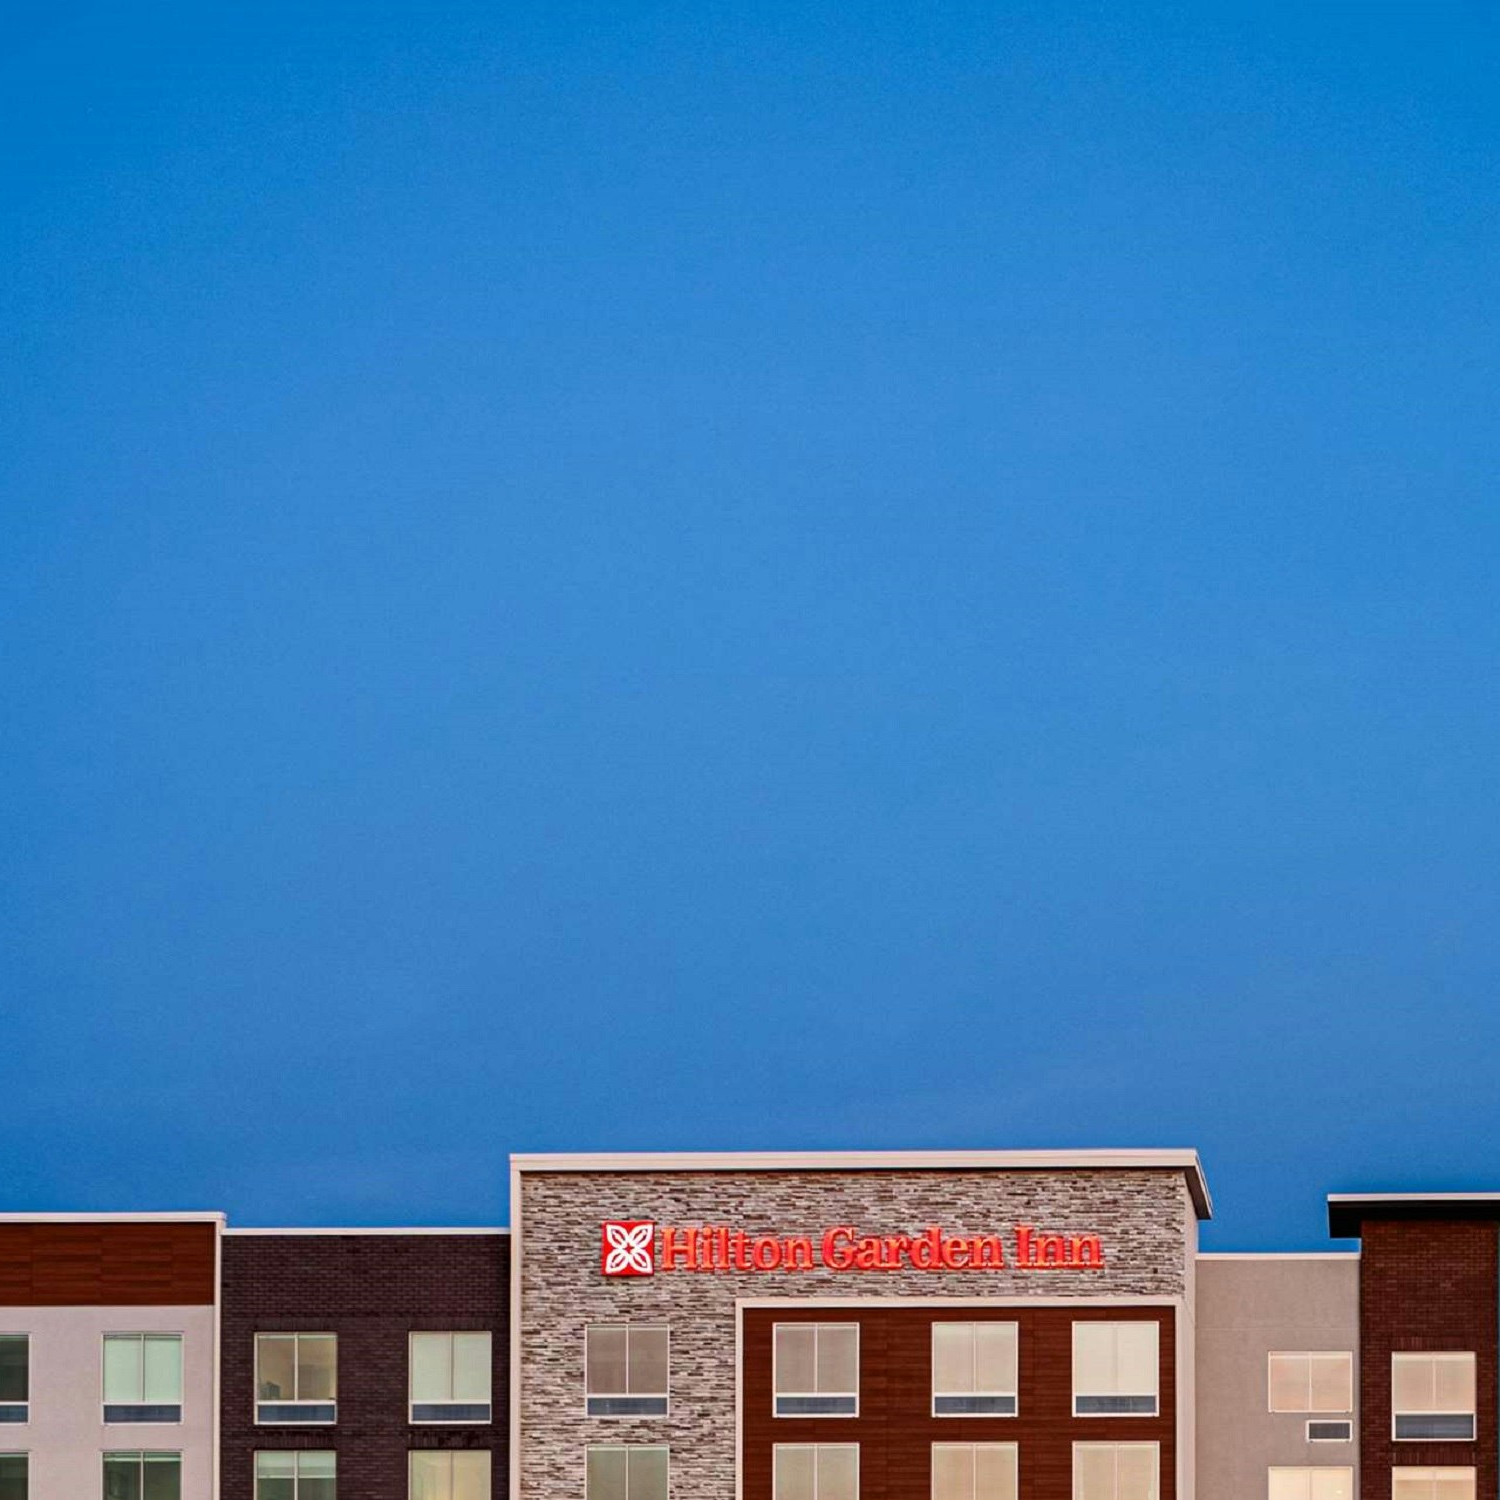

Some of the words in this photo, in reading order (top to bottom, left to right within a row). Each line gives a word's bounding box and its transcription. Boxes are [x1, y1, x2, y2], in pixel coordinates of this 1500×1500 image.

[660, 1226, 814, 1271] Hilton
[821, 1225, 1004, 1271] Garden
[1014, 1225, 1105, 1270] Inn
